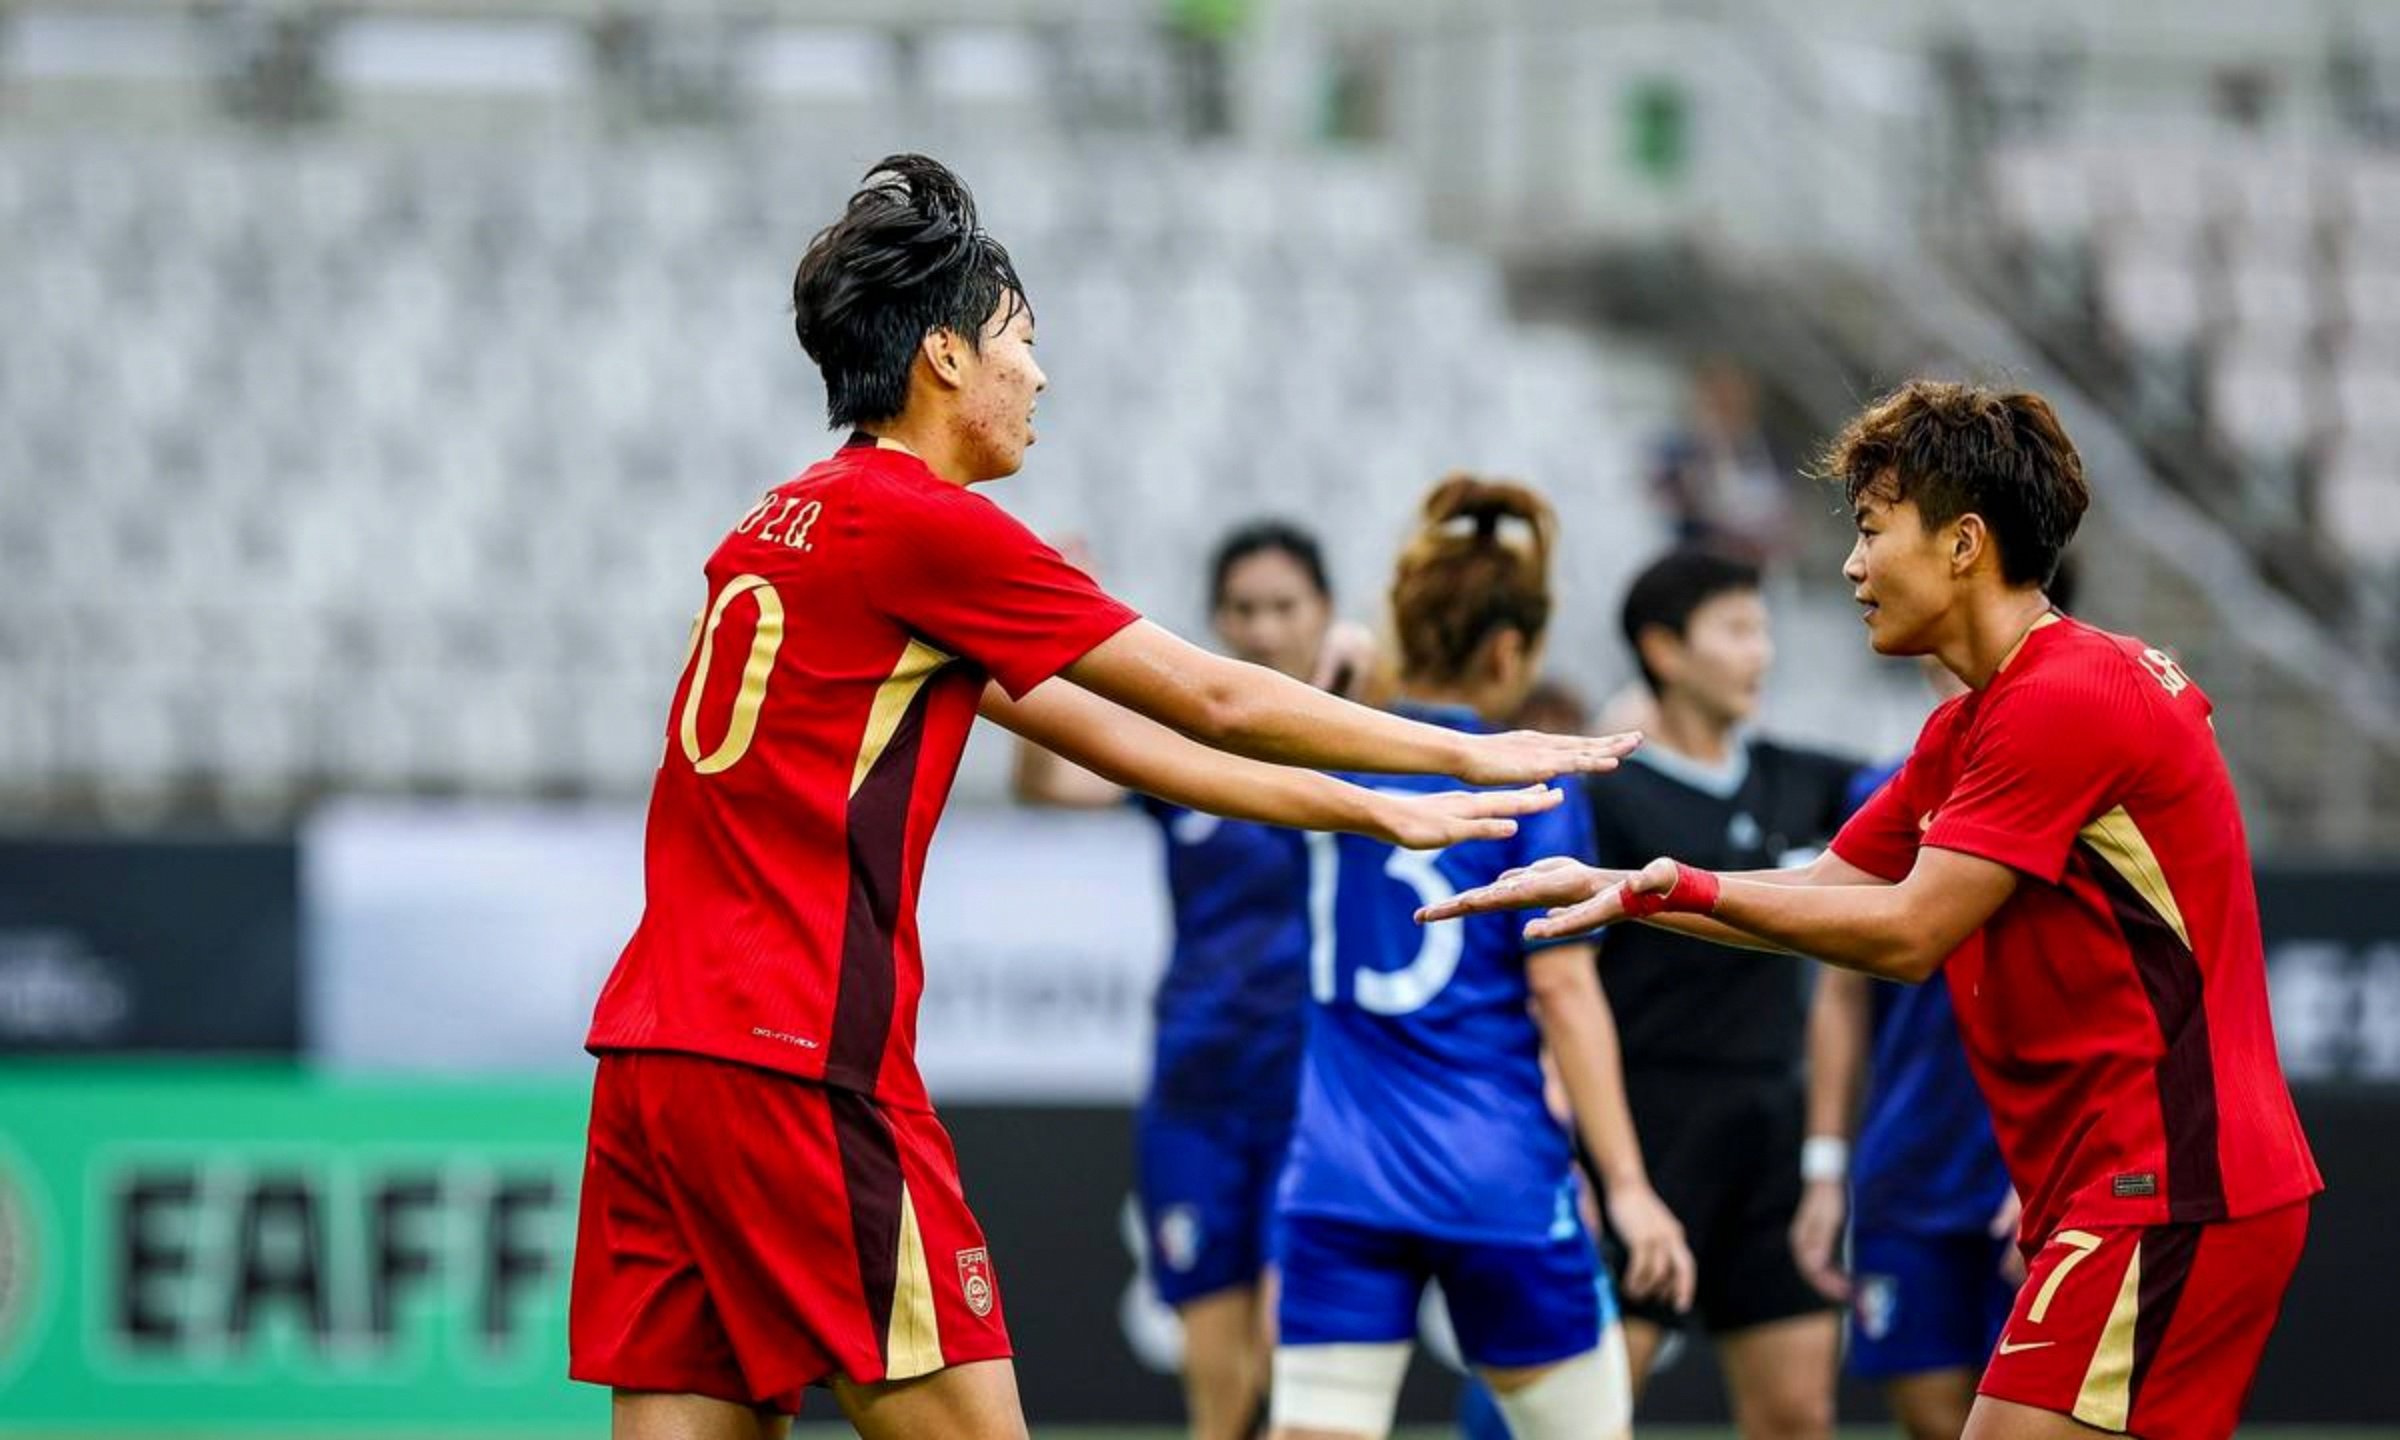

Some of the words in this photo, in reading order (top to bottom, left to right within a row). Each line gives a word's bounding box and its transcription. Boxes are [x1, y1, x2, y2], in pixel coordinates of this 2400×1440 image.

[664, 573, 784, 774] 0
[1303, 787, 1465, 1015] 13
[114, 1166, 562, 1358] EAFF
[2027, 1229, 2103, 1324] 7
